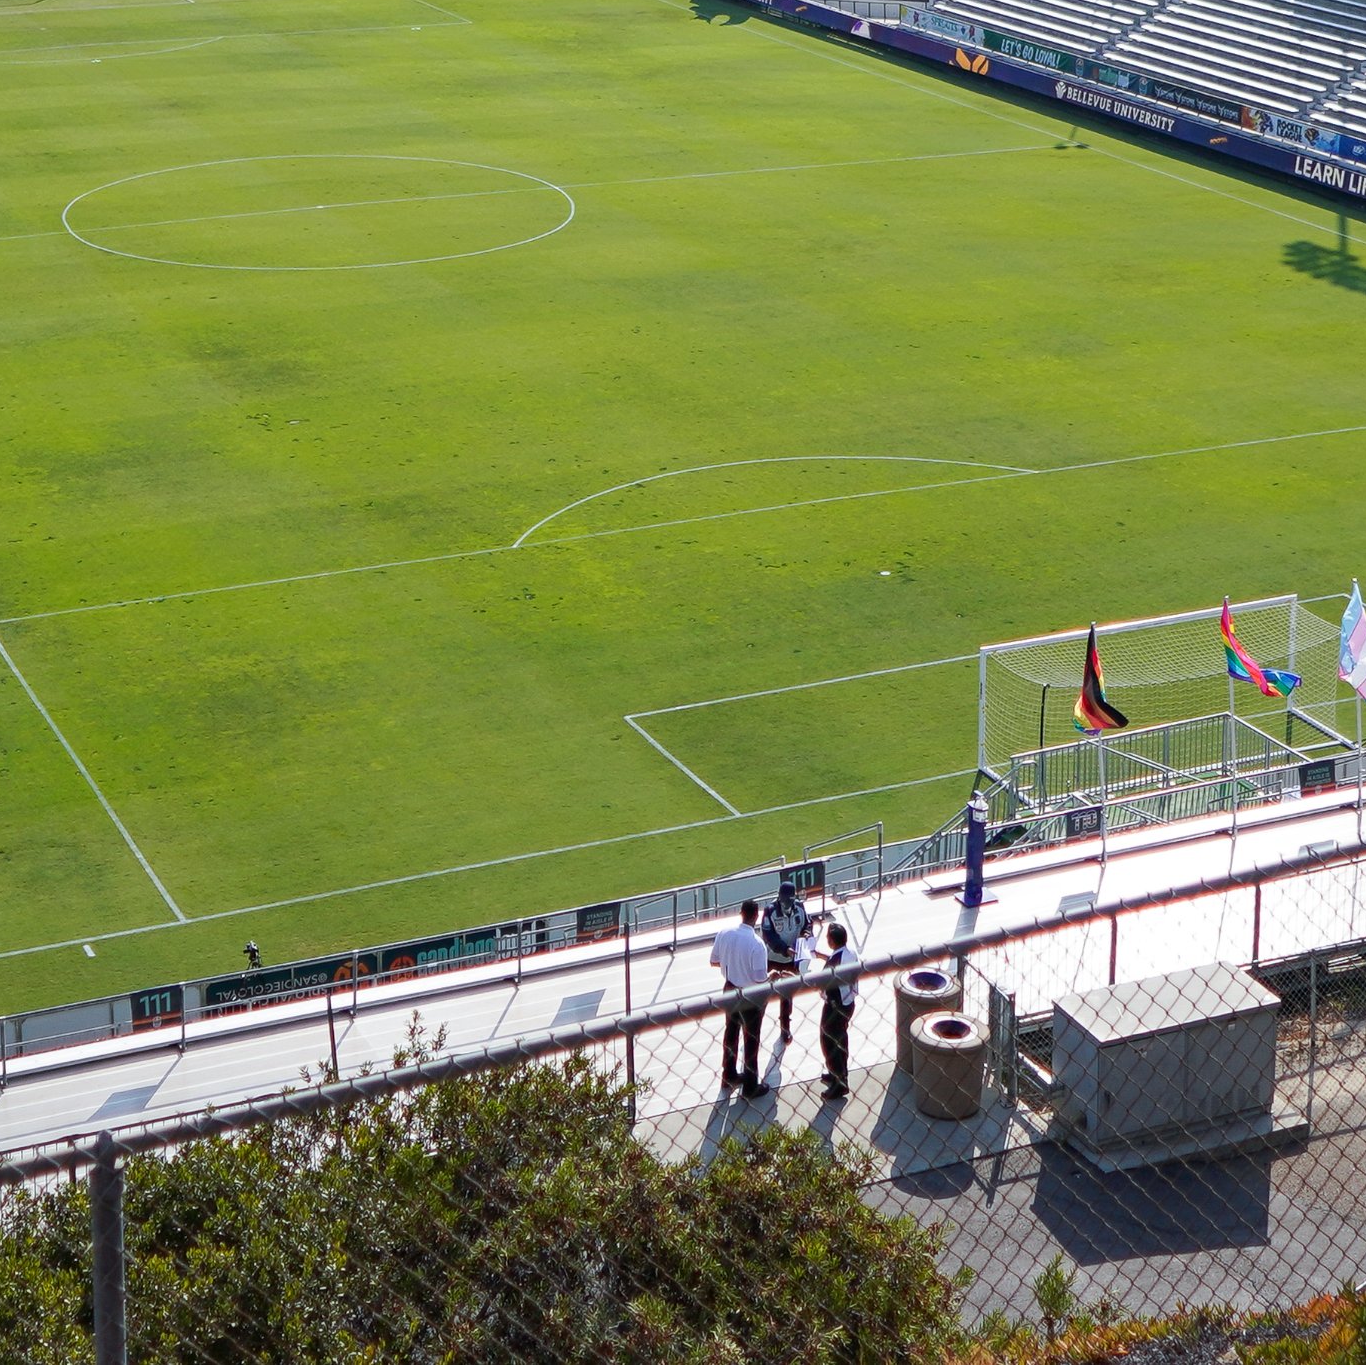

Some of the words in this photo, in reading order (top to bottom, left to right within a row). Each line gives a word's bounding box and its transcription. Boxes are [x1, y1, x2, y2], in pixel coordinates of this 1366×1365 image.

[1001, 38, 1023, 58] LET'S
[1024, 45, 1034, 60] GO
[1035, 48, 1061, 69] LOYAL!
[1066, 88, 1112, 113] BELLEVUE
[1113, 100, 1175, 133] UNIVERSITY
[1276, 127, 1303, 143] LEAGUE
[1277, 118, 1303, 133] ROCKET
[1295, 155, 1345, 189] LEARN
[788, 866, 816, 889] 111
[139, 991, 172, 1017] 111
